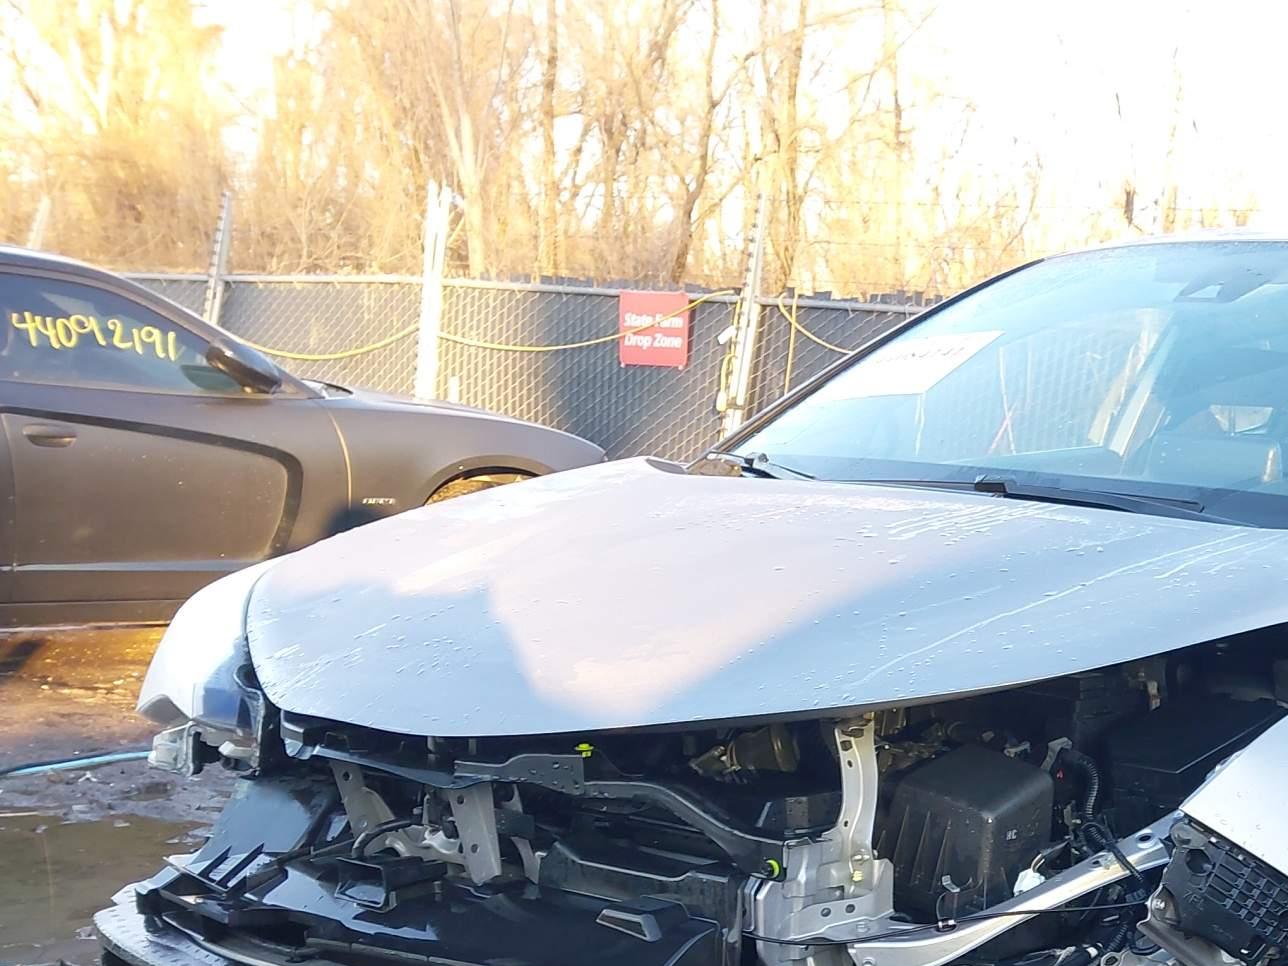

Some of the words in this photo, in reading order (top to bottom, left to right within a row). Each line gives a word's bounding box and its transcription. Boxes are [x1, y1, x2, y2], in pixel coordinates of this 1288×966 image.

[624, 312, 653, 327] State
[655, 313, 684, 328] Farm
[11, 311, 177, 362] 44092191
[624, 333, 652, 349] Drop
[653, 333, 683, 348] Zone
